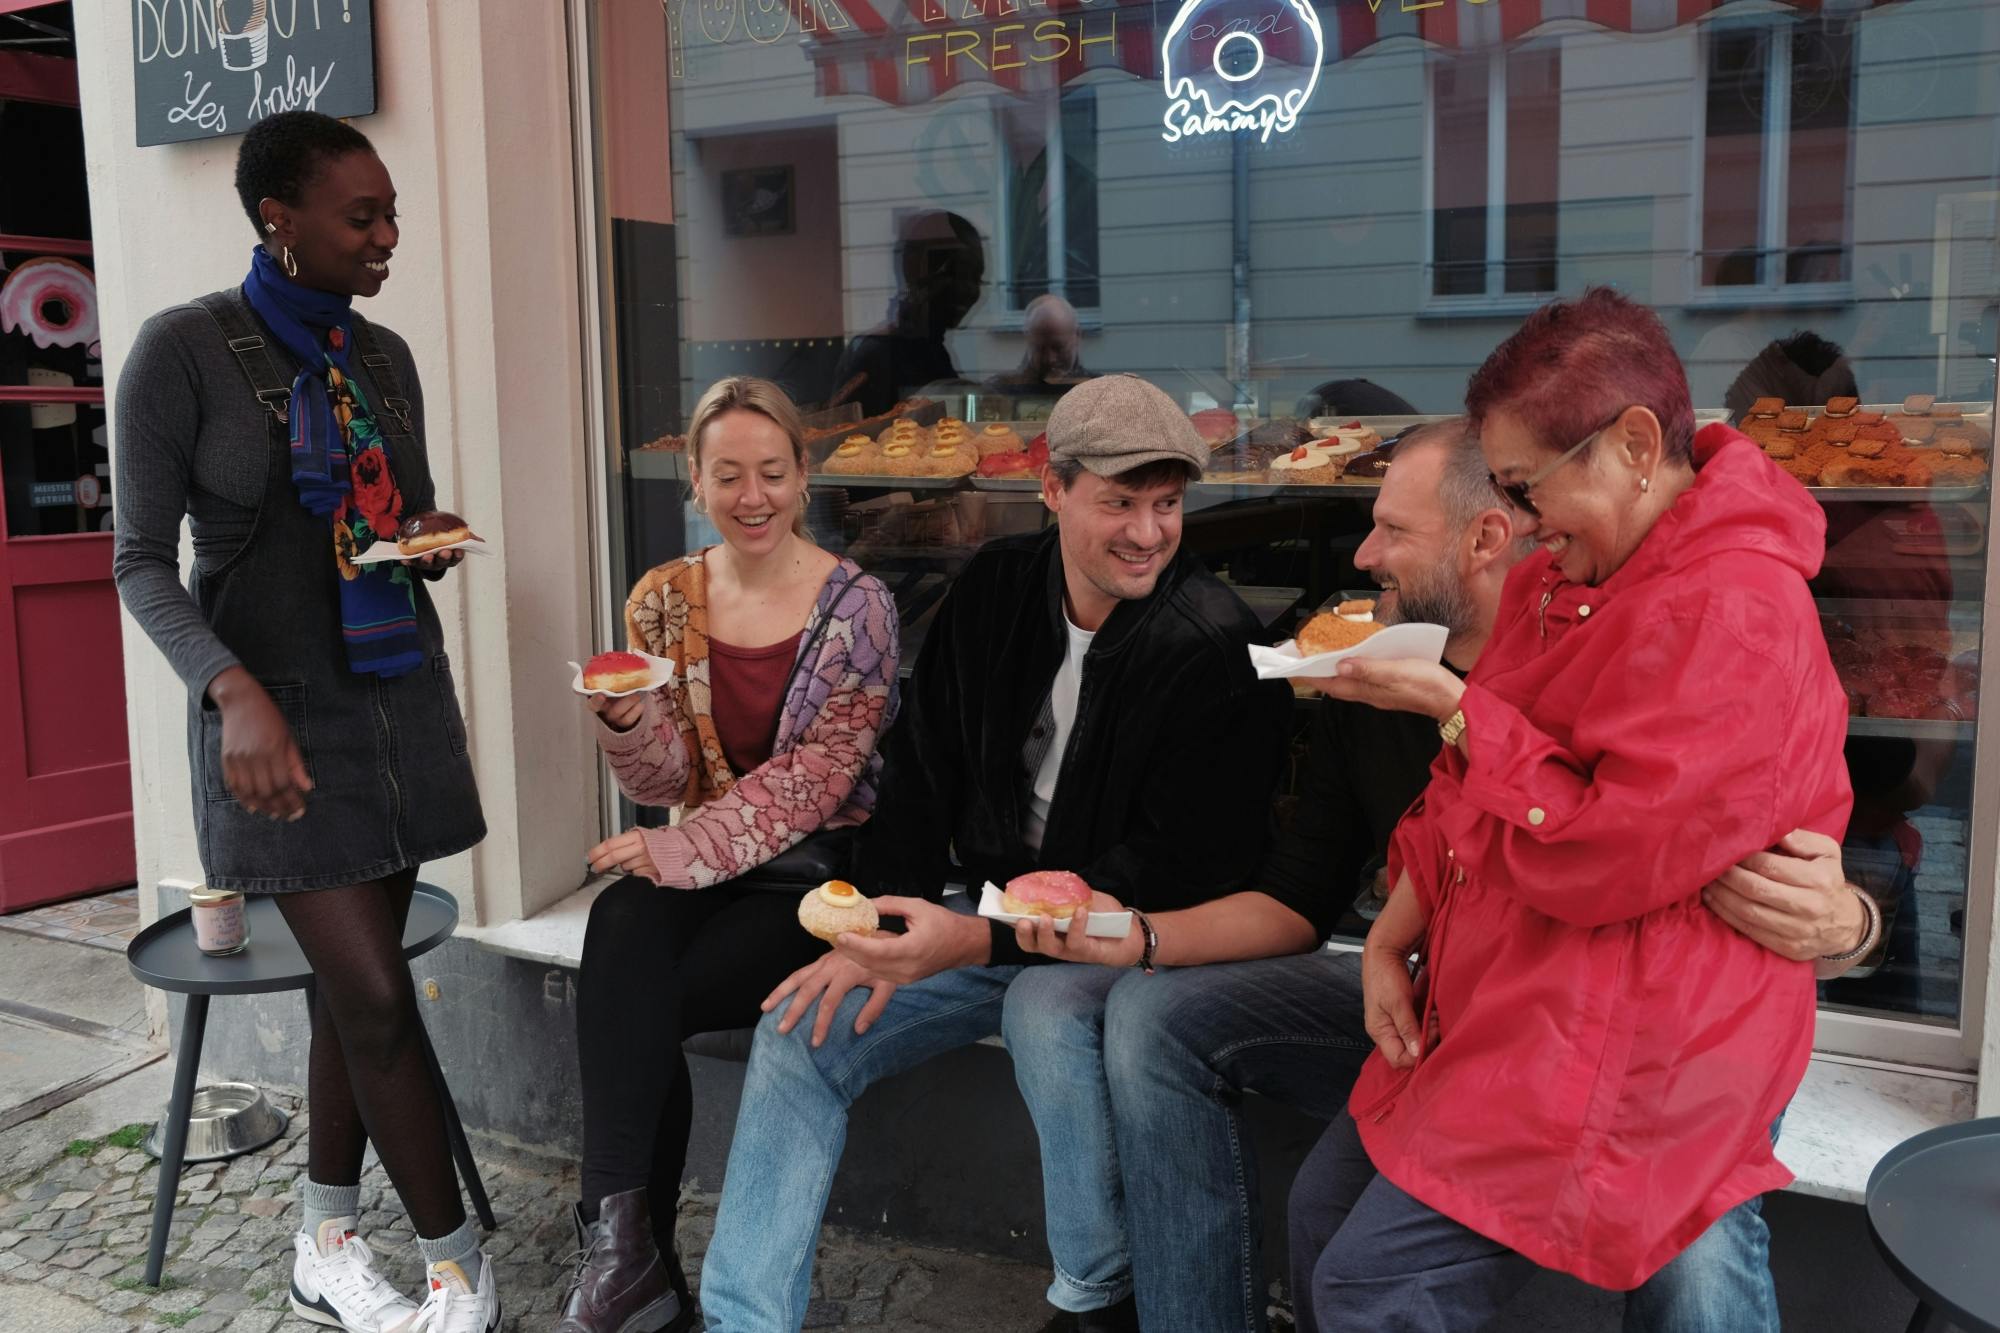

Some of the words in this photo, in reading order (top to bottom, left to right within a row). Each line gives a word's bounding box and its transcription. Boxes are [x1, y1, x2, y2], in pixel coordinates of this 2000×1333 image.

[906, 11, 1117, 88] FRESH
[168, 70, 227, 133] Yes
[247, 54, 336, 119] baby
[34, 483, 73, 493] MEISTER
